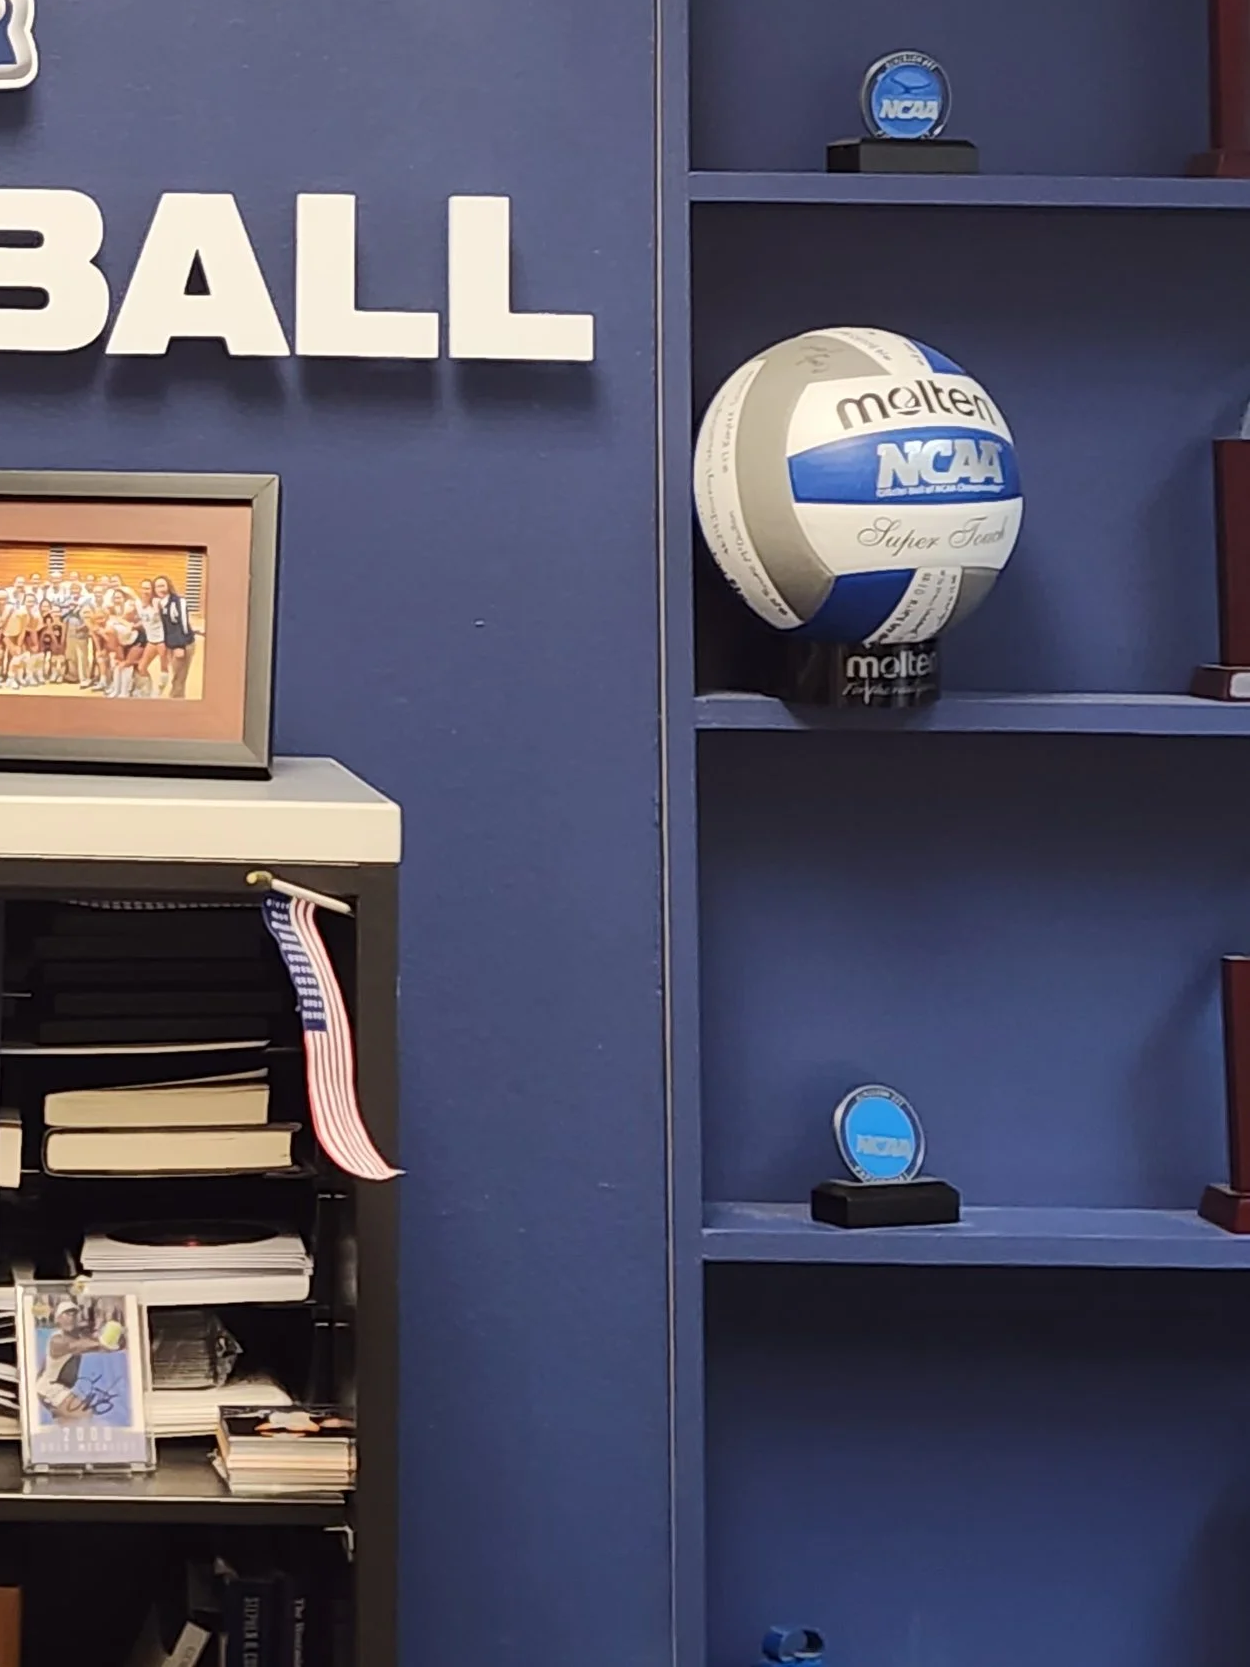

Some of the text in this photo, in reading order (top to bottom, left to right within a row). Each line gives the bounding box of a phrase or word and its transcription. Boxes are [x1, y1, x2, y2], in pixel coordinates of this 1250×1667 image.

[878, 98, 939, 120] NCAA
[836, 378, 996, 431] molten
[876, 438, 1005, 488] NCAA
[857, 516, 940, 557] Super
